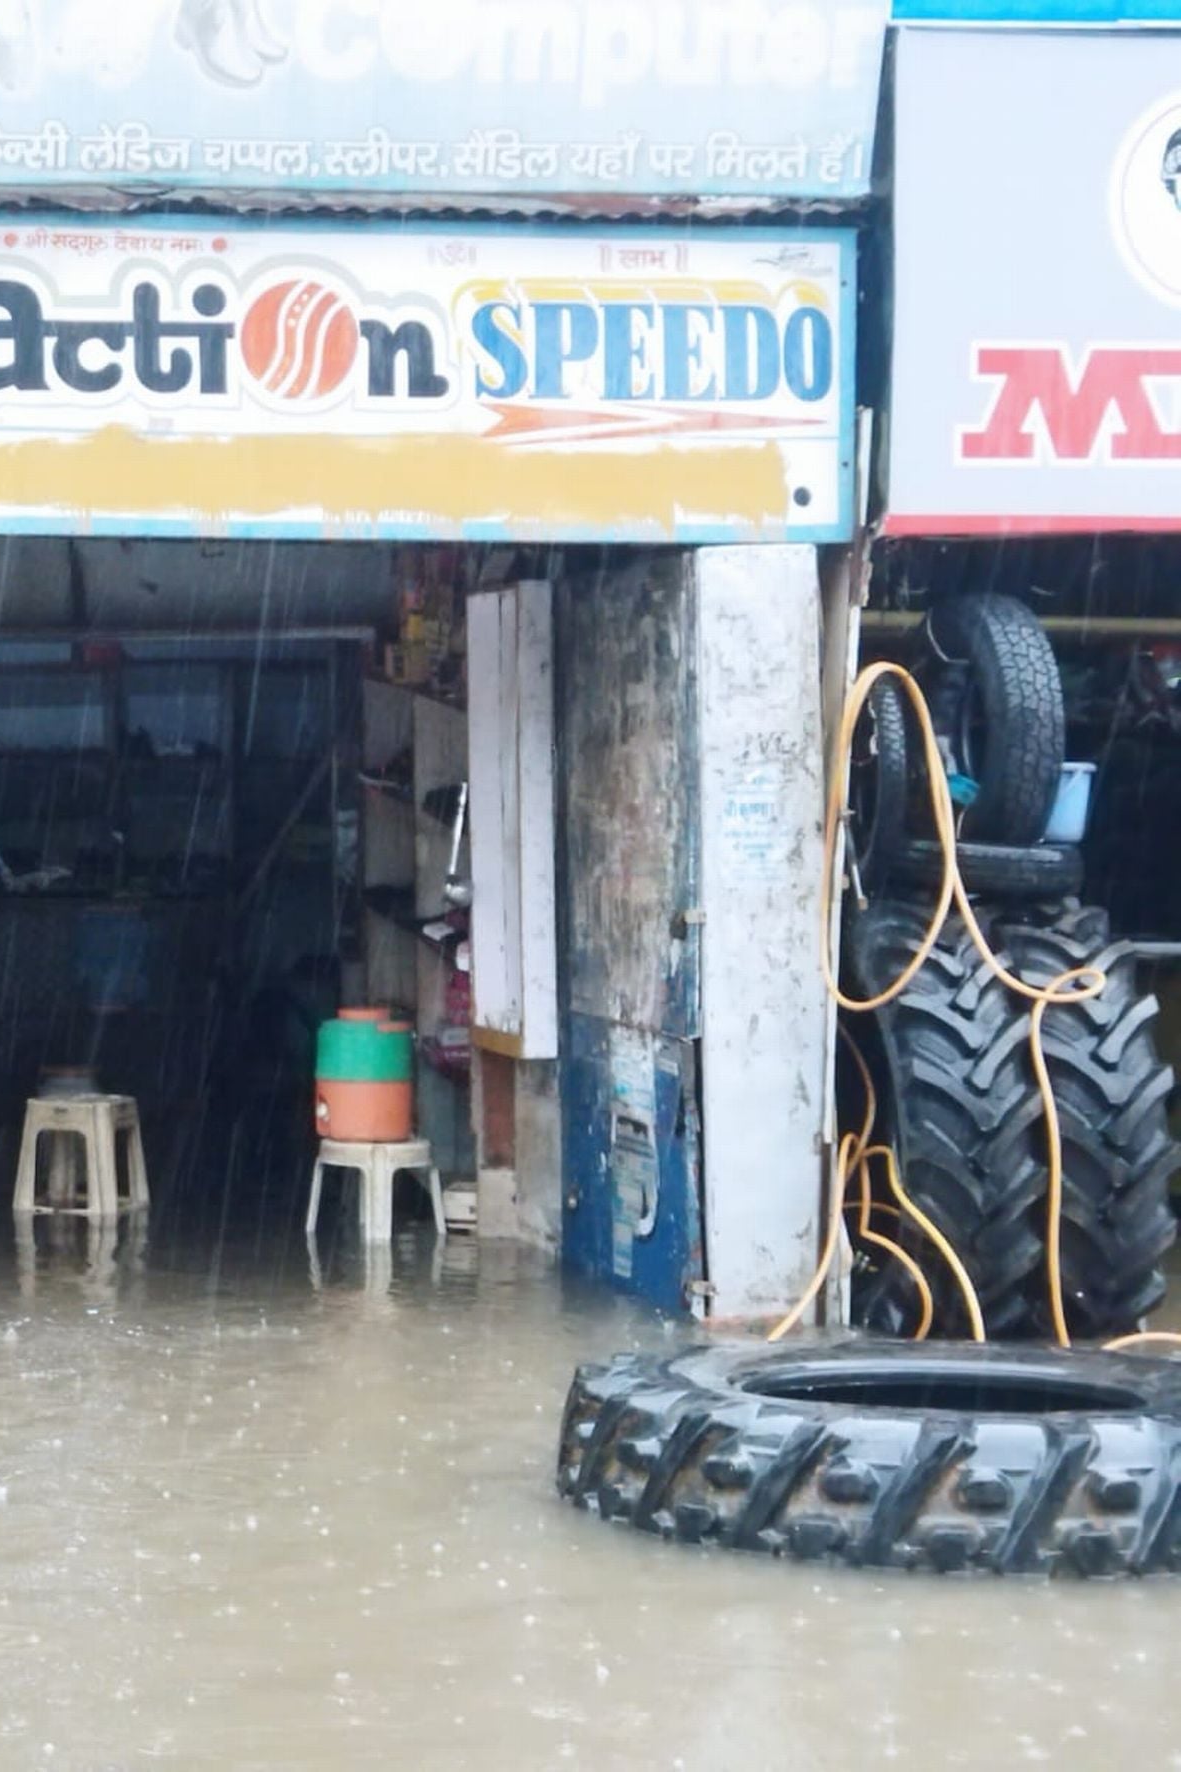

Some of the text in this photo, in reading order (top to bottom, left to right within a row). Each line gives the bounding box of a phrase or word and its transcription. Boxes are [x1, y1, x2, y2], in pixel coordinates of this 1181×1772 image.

[648, 142, 696, 178] पर
[706, 130, 808, 180] मिलते
[471, 299, 833, 402] SPEEDO
